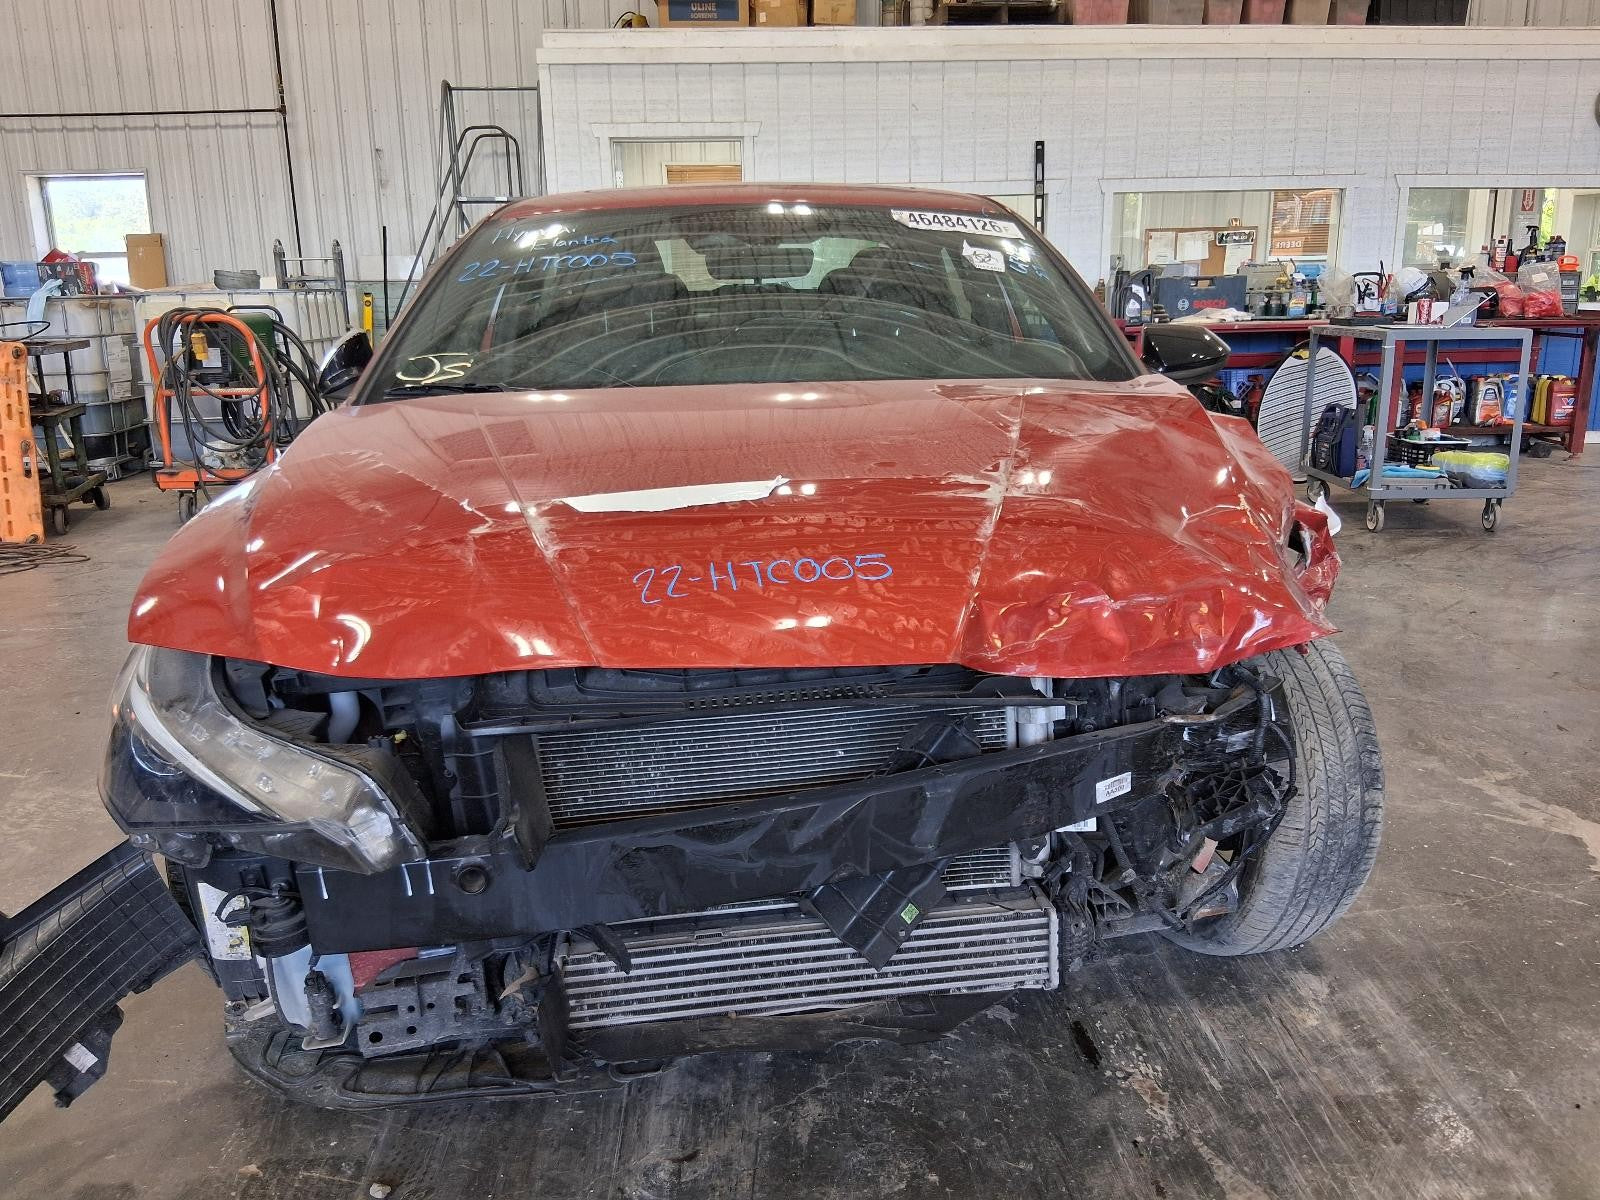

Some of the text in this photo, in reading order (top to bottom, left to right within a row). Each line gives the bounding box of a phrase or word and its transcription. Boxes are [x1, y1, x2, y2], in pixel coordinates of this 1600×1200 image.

[691, 2, 717, 11] ULINE
[908, 212, 1003, 233] 46484126
[458, 252, 637, 283] 22-HTC005
[632, 553, 893, 604] 22-HTC005
